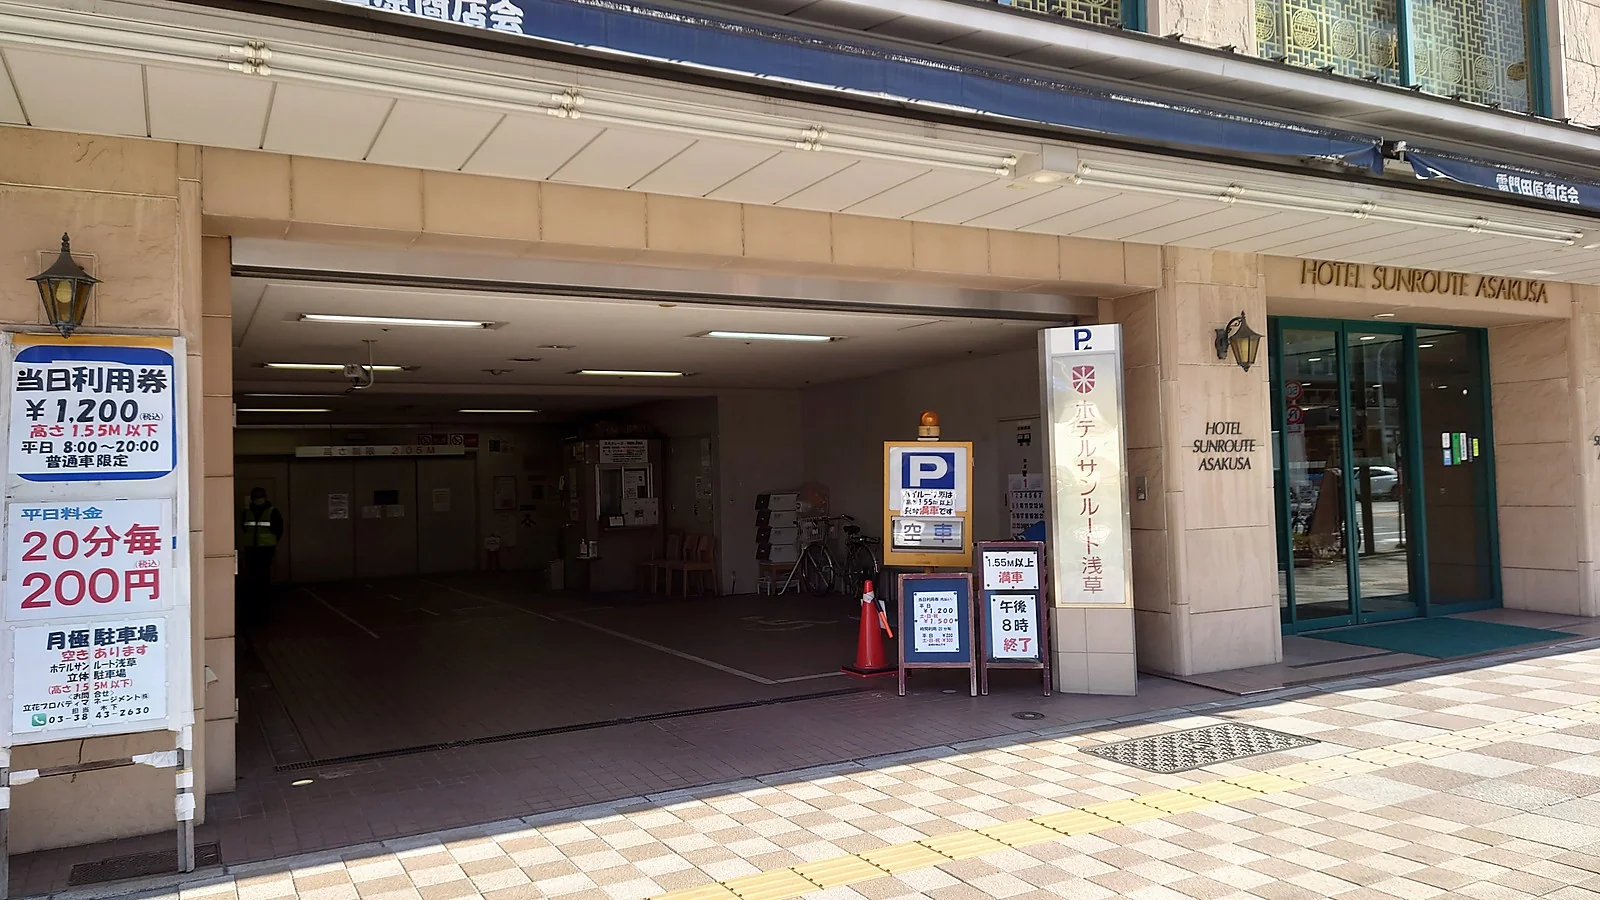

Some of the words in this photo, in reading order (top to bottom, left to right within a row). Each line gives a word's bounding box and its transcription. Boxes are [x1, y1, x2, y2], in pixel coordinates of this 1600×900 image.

[1300, 260, 1365, 288] HOTEL
[1372, 266, 1470, 296] SUNROUTE
[1475, 276, 1548, 304] ASAKUSA
[16, 367, 167, 393] 当日利用券
[30, 424, 65, 438] 高さ
[72, 425, 120, 437] 1.55M
[125, 424, 158, 437] 以下
[1206, 422, 1242, 435] HOTEL
[22, 441, 54, 454] 平日
[1192, 439, 1256, 453] SUNROUTE
[45, 454, 128, 468] 普通車限定
[1198, 457, 1251, 471] ASAKUSA
[910, 456, 948, 486] P
[1076, 400, 1104, 594] ホテルサンルート浅草
[21, 506, 103, 521] 平日料金
[904, 523, 953, 543] 空車
[22, 524, 162, 562] 20分毎
[998, 571, 1024, 584] 満車
[21, 568, 160, 609] 200円
[1000, 600, 1027, 614] 午後
[1002, 618, 1028, 632] 8時
[46, 625, 158, 650] 月極駐車場
[1004, 638, 1032, 652] 終了
